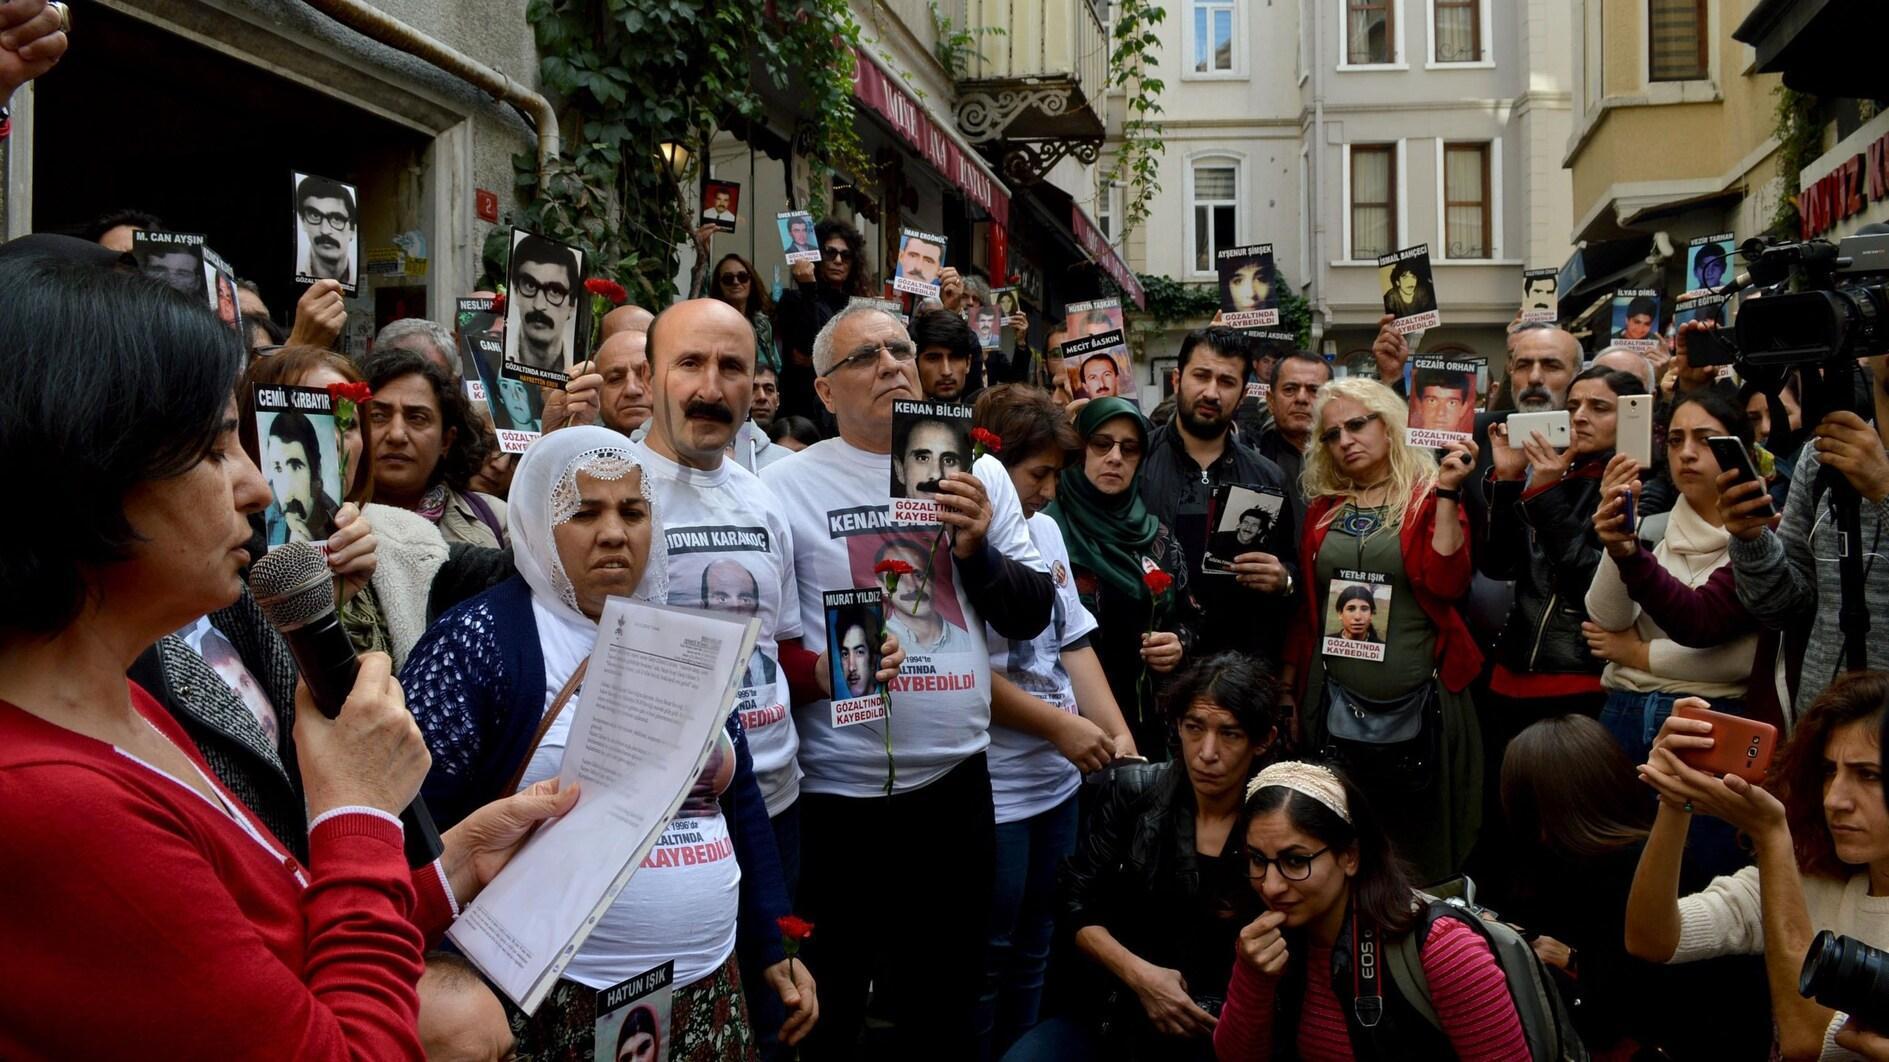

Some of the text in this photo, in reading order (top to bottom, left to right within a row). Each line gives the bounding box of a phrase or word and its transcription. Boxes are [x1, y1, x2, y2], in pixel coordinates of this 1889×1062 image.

[136, 232, 148, 241] M.
[150, 233, 172, 243] CAN
[1218, 245, 1272, 258] AYŞENUR ŞİMŞEK
[1398, 321, 1437, 333] AYBEDİLDİ
[1066, 338, 1090, 355] MECİT
[1415, 359, 1445, 370] CEZAİR
[1446, 362, 1475, 372] ORHAN
[258, 387, 288, 407] CEMİL
[895, 402, 973, 419] KENAN BİLGİN
[830, 511, 892, 533] KENAN
[896, 511, 941, 522] KAYBE
[665, 531, 767, 551] IDVAN KARAKOÇ
[1340, 570, 1385, 583] YETER IŞIK
[826, 591, 881, 606] MURAT YILDIZ
[888, 669, 975, 692] AYBEDİLDİ
[836, 708, 885, 725] KAYBEDİLD
[639, 837, 733, 868] KAYBEDİLD
[1361, 942, 1374, 979] EOS
[608, 967, 666, 1007] HATUN IŞIK
